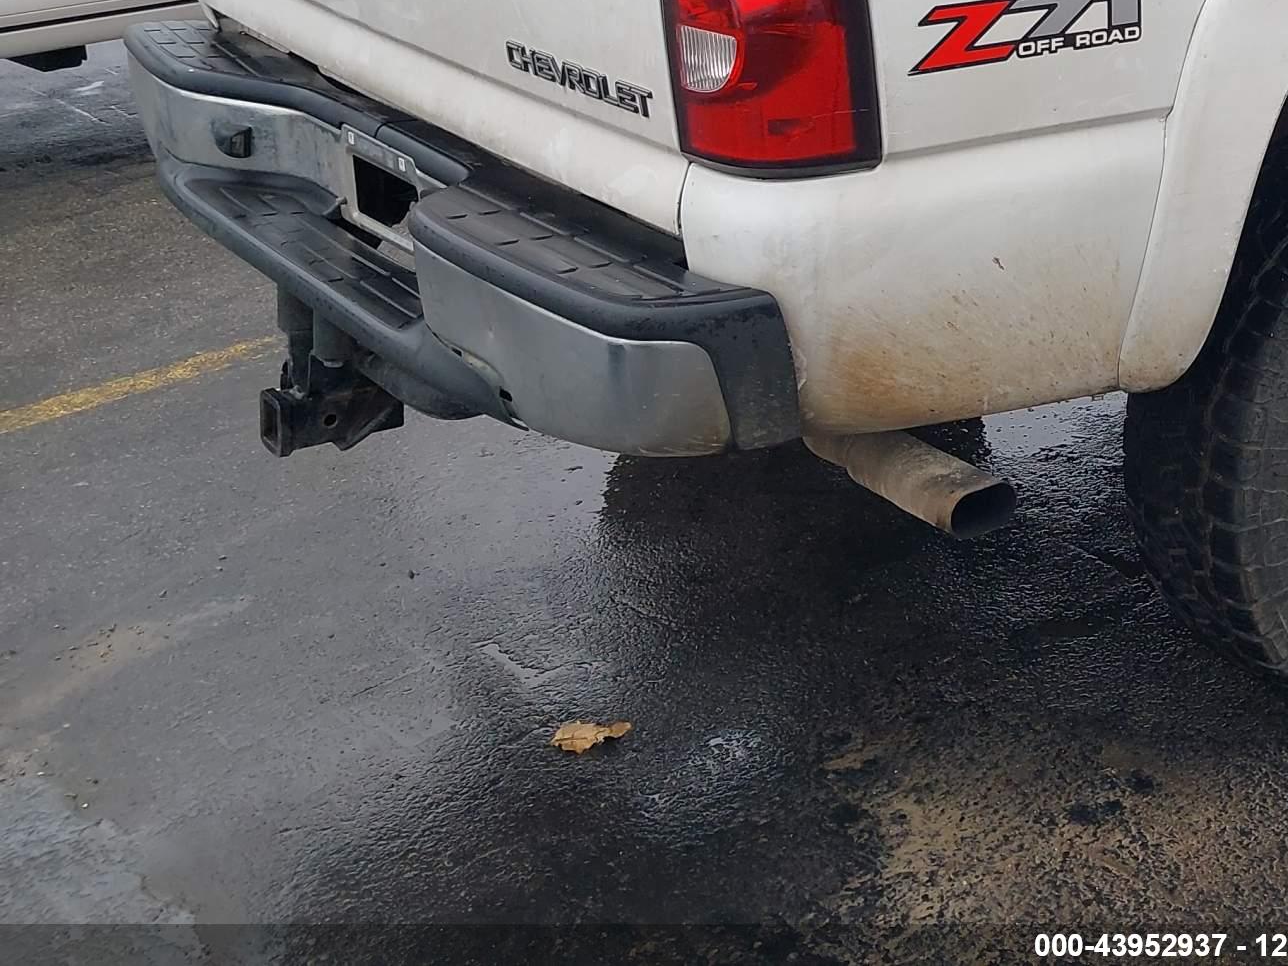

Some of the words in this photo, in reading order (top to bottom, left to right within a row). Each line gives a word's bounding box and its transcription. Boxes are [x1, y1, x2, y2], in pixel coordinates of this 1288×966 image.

[1016, 38, 1065, 58] OFF
[1075, 26, 1140, 49] ROAD
[506, 40, 653, 118] CHEVROLET
